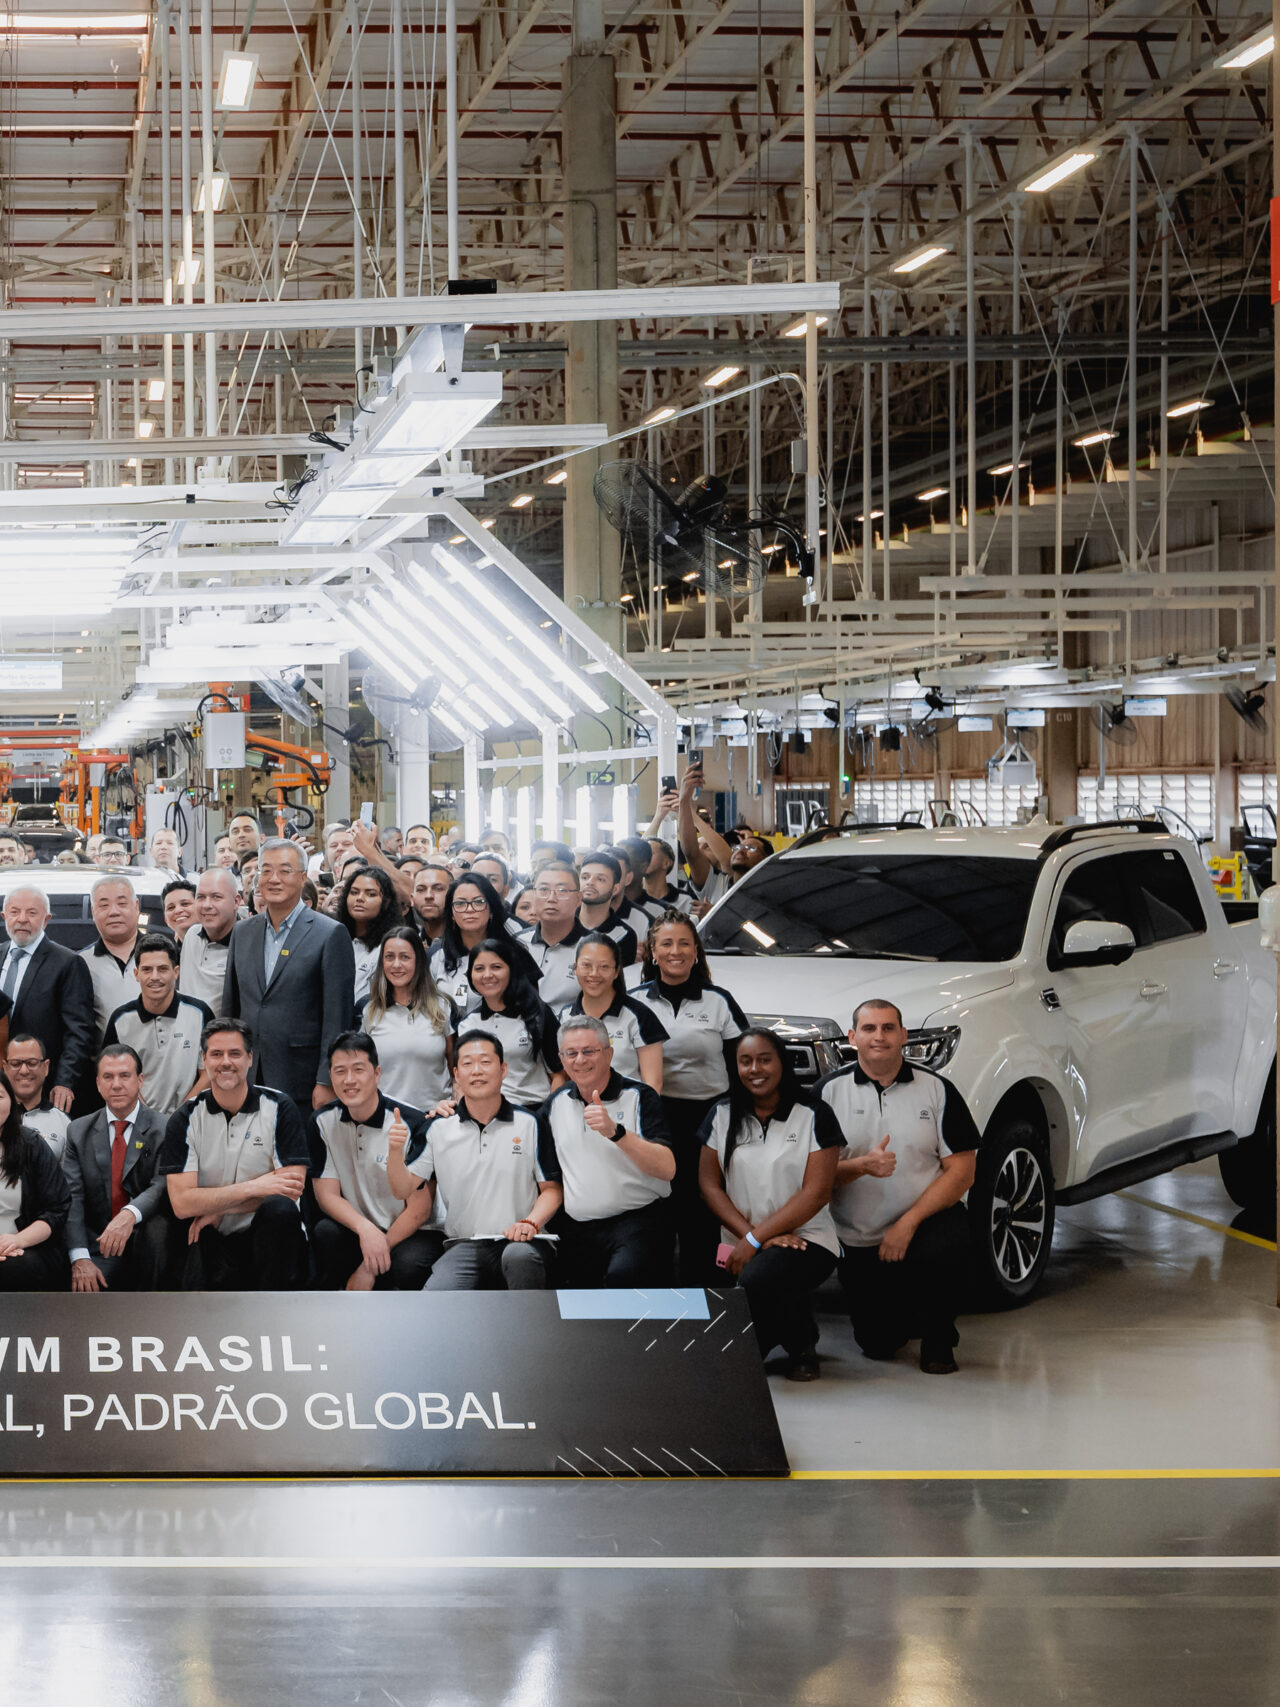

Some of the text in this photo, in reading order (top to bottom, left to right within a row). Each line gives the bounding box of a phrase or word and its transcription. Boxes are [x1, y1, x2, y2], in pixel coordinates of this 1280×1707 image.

[88, 1335, 329, 1373] BRASIL:
[63, 1384, 288, 1431] PADRÃO
[304, 1392, 537, 1430] GLOBAL.
